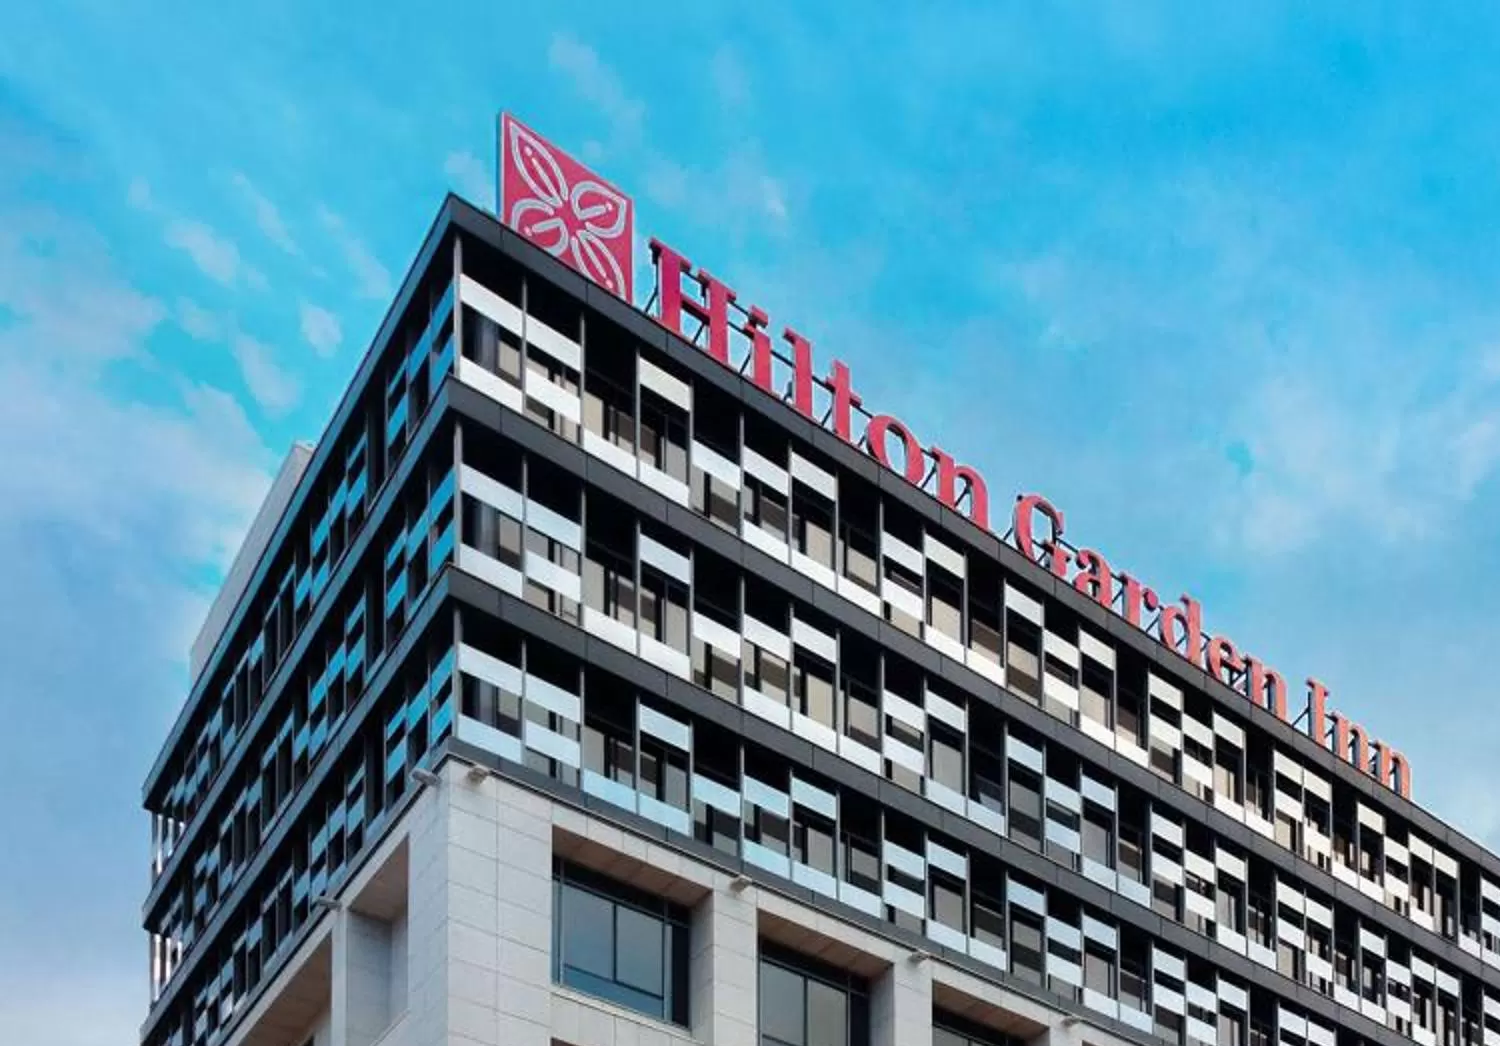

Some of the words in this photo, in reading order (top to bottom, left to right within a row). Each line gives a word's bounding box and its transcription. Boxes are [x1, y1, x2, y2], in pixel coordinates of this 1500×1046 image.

[649, 237, 990, 531] Hilton
[1013, 493, 1288, 720] Garden
[1306, 676, 1412, 801] Inn
